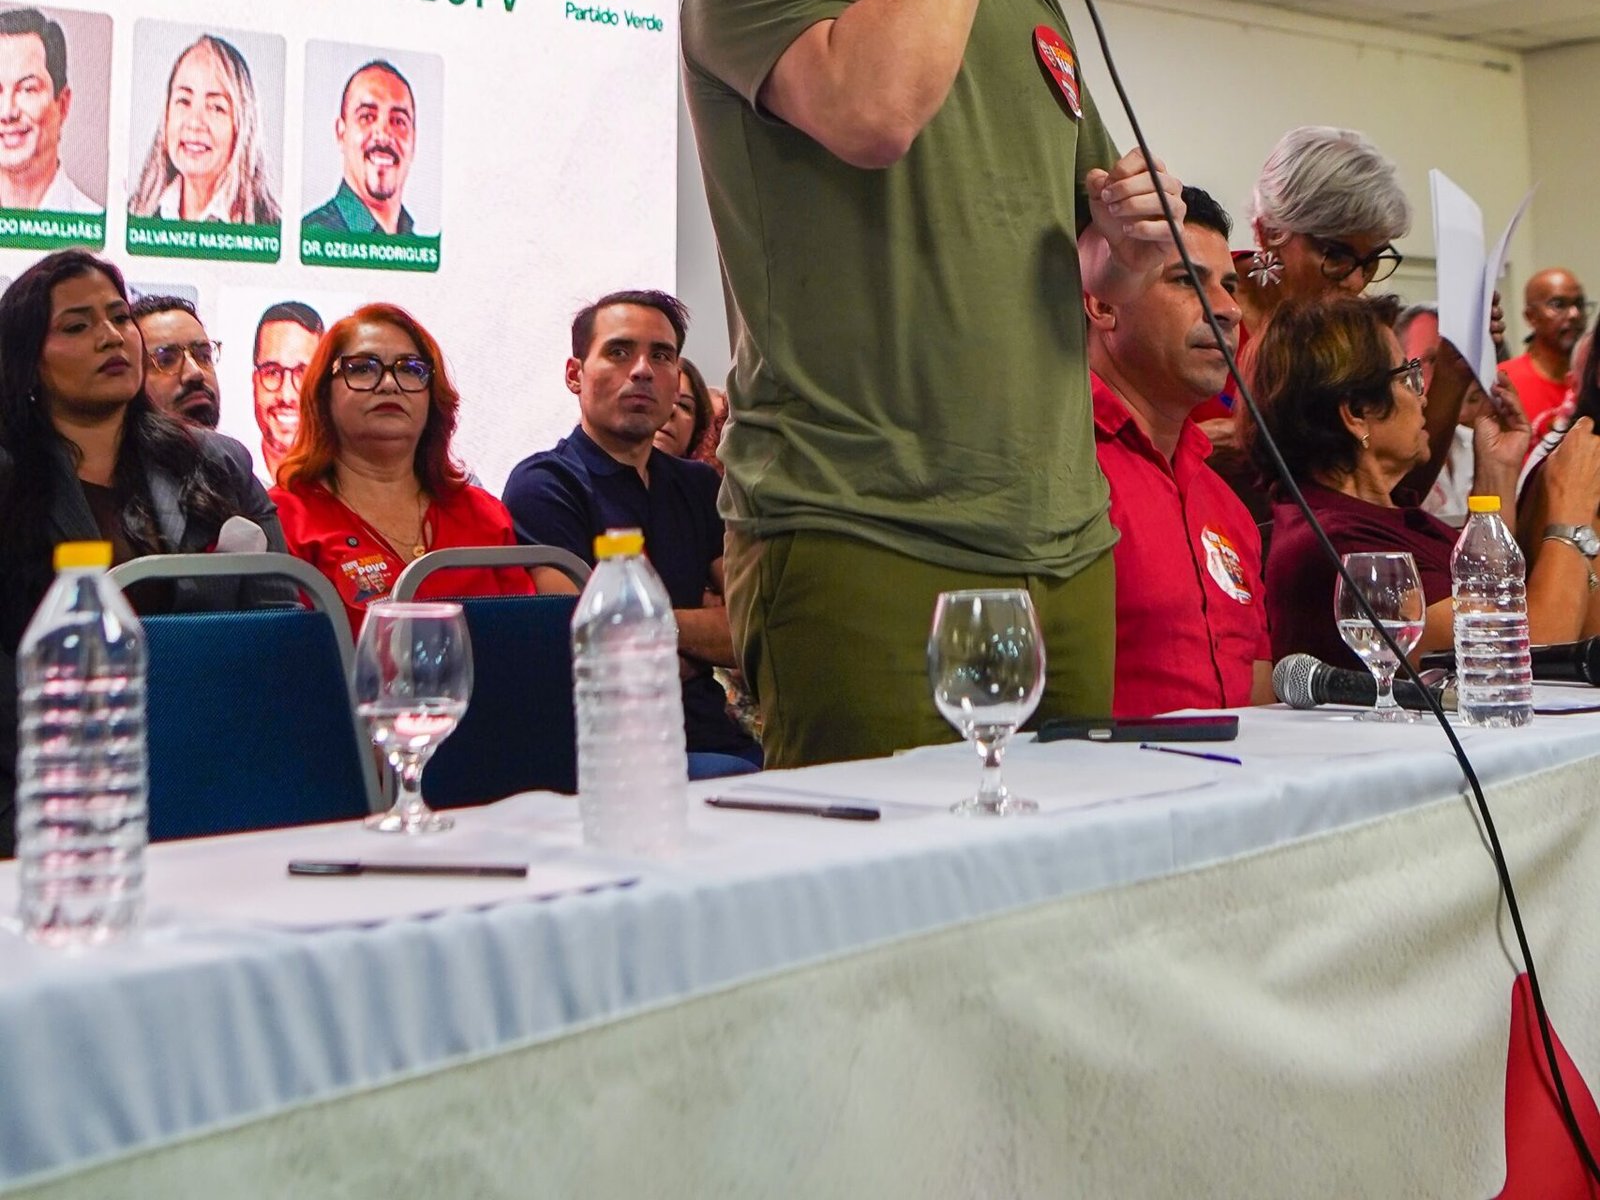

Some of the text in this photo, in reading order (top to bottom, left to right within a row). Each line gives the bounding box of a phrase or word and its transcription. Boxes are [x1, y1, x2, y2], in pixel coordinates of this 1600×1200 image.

[565, 1, 664, 32] Partido Verde
[19, 219, 102, 240] MAGALHÃES
[128, 227, 280, 253] DALVANIZE NASCIMENTO
[302, 239, 438, 264] DR. OZEIAS RODRIGUES
[357, 561, 387, 576] POVO
